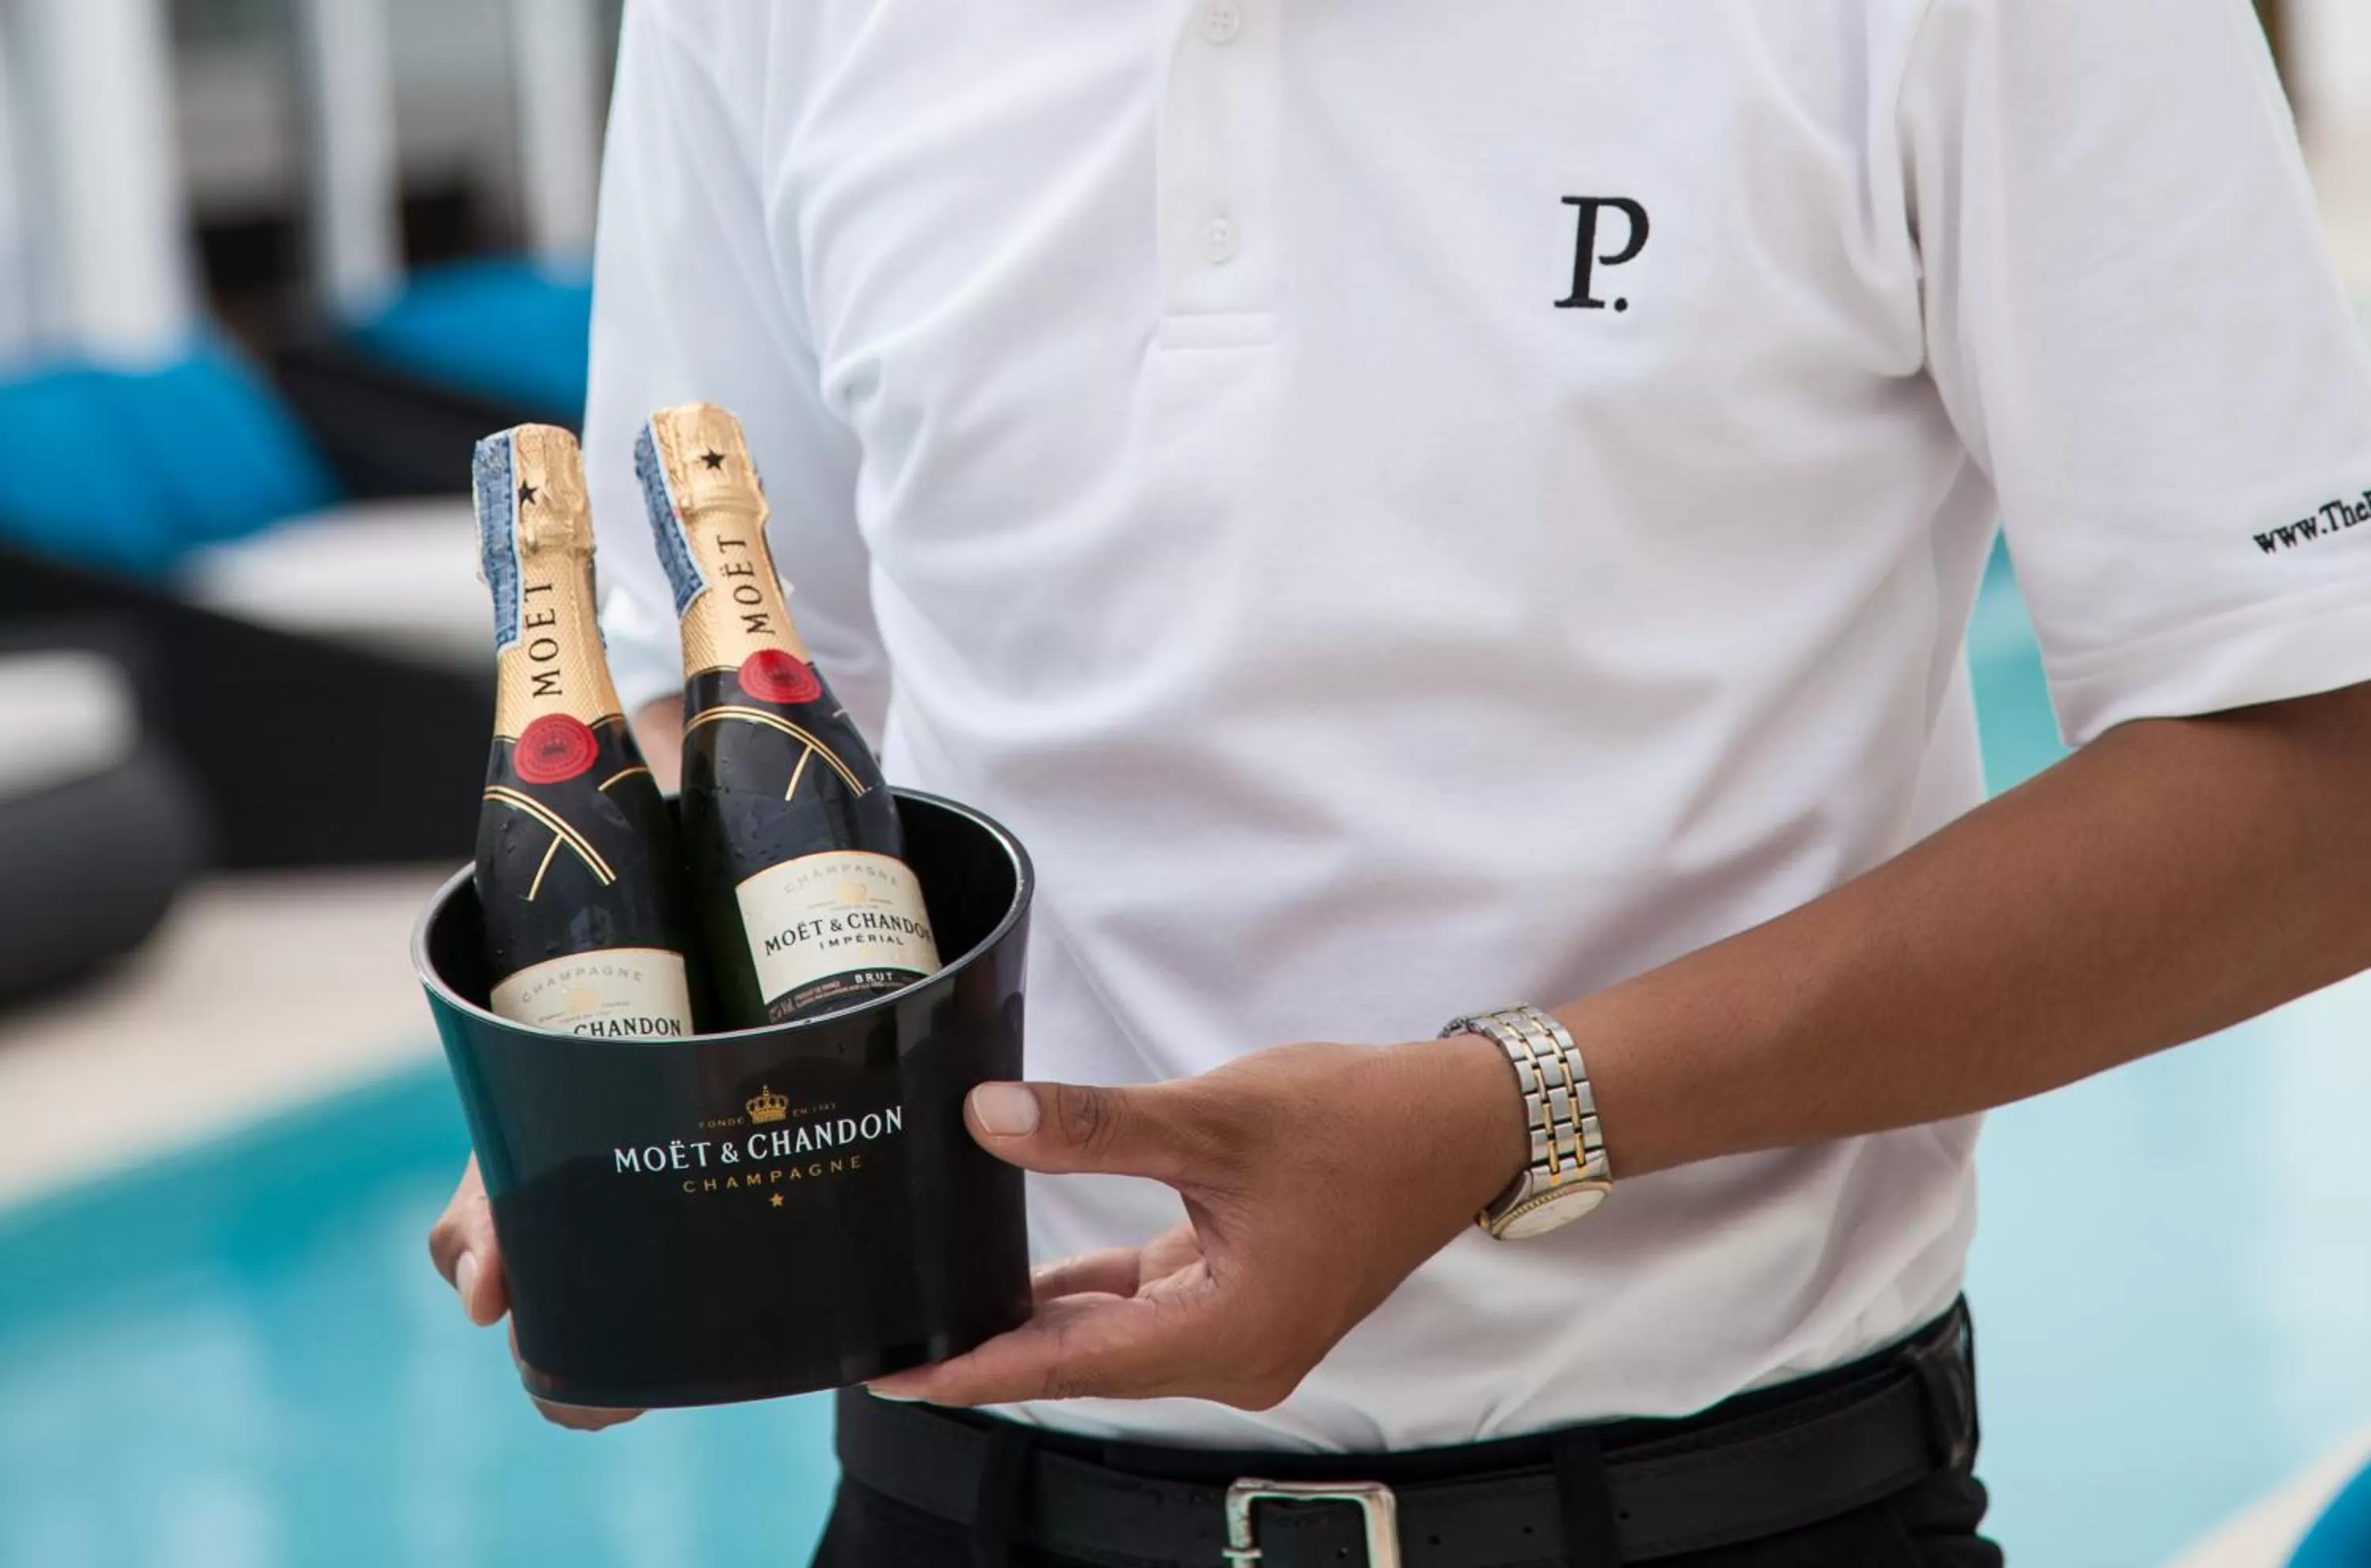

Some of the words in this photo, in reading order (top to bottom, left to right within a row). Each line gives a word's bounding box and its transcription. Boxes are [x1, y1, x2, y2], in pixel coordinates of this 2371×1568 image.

[715, 534, 776, 635] MOËT
[783, 862, 899, 895] CHAMPAGNE
[764, 919, 824, 957] MOËT
[830, 917, 842, 933] &
[819, 932, 905, 951] IMPÉRIAL
[522, 964, 643, 1003] CHAMPAGNE
[854, 971, 893, 984] BRUT
[613, 1139, 712, 1174] MOËT
[720, 1141, 741, 1164] &
[746, 1105, 903, 1160] CHANDON
[682, 1155, 862, 1194] CHAMPAGNE
